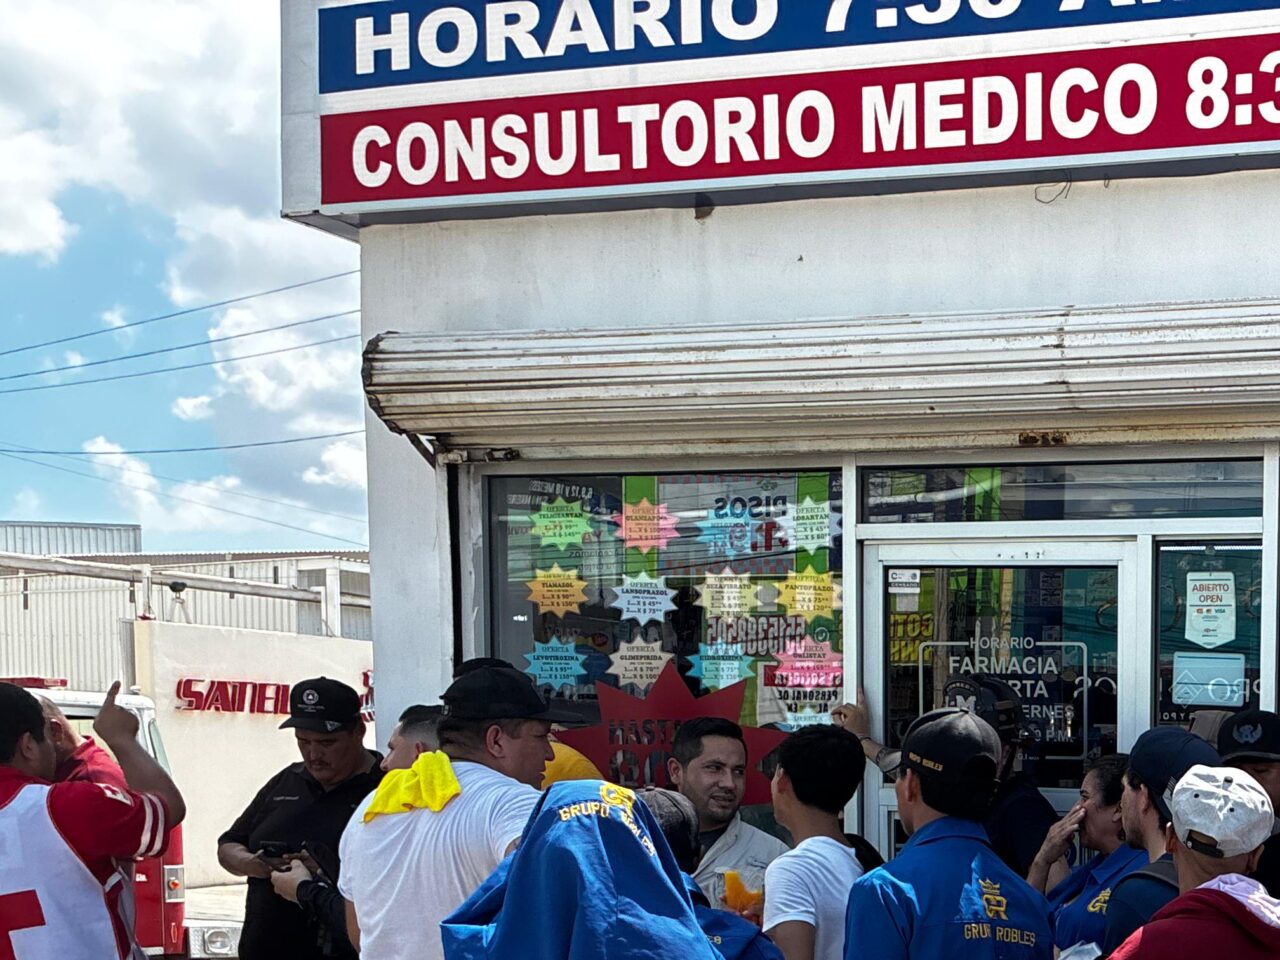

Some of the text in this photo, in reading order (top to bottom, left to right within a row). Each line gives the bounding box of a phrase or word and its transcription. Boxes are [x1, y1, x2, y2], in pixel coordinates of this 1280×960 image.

[356, 0, 777, 74] HORARIO
[353, 91, 834, 187] CONSULTORIO
[862, 64, 1157, 152] MEDICO
[621, 588, 668, 596] LANSOPRAZOL
[1192, 583, 1229, 592] ABIERTO
[1198, 594, 1223, 603] OPEN
[970, 637, 1034, 649] HORARIO
[950, 656, 1058, 674] FARMACIA
[559, 801, 609, 821] GRUPO
[996, 926, 1036, 947] ROBLES
